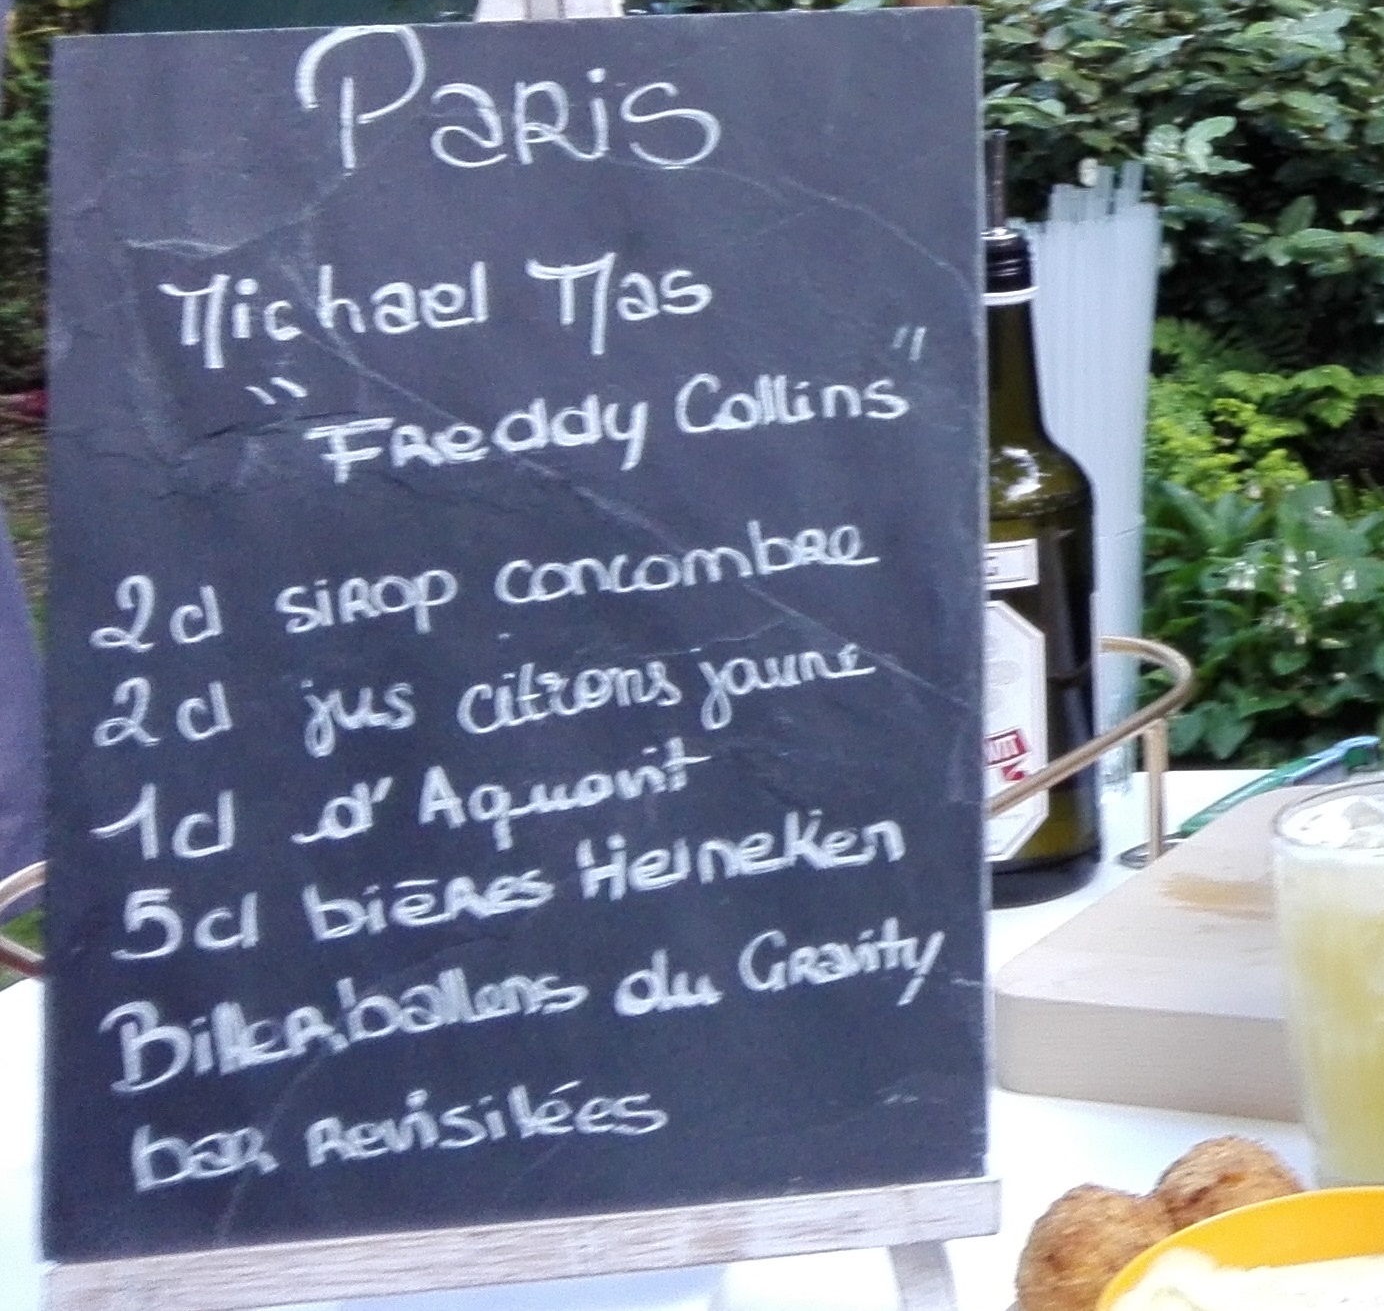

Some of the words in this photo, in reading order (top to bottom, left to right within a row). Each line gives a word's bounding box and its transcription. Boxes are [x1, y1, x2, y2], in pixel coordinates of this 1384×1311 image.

[157, 262, 487, 370] Michael
[303, 677, 416, 758] jus
[613, 949, 722, 1017] du
[737, 915, 947, 1007] Gravity
